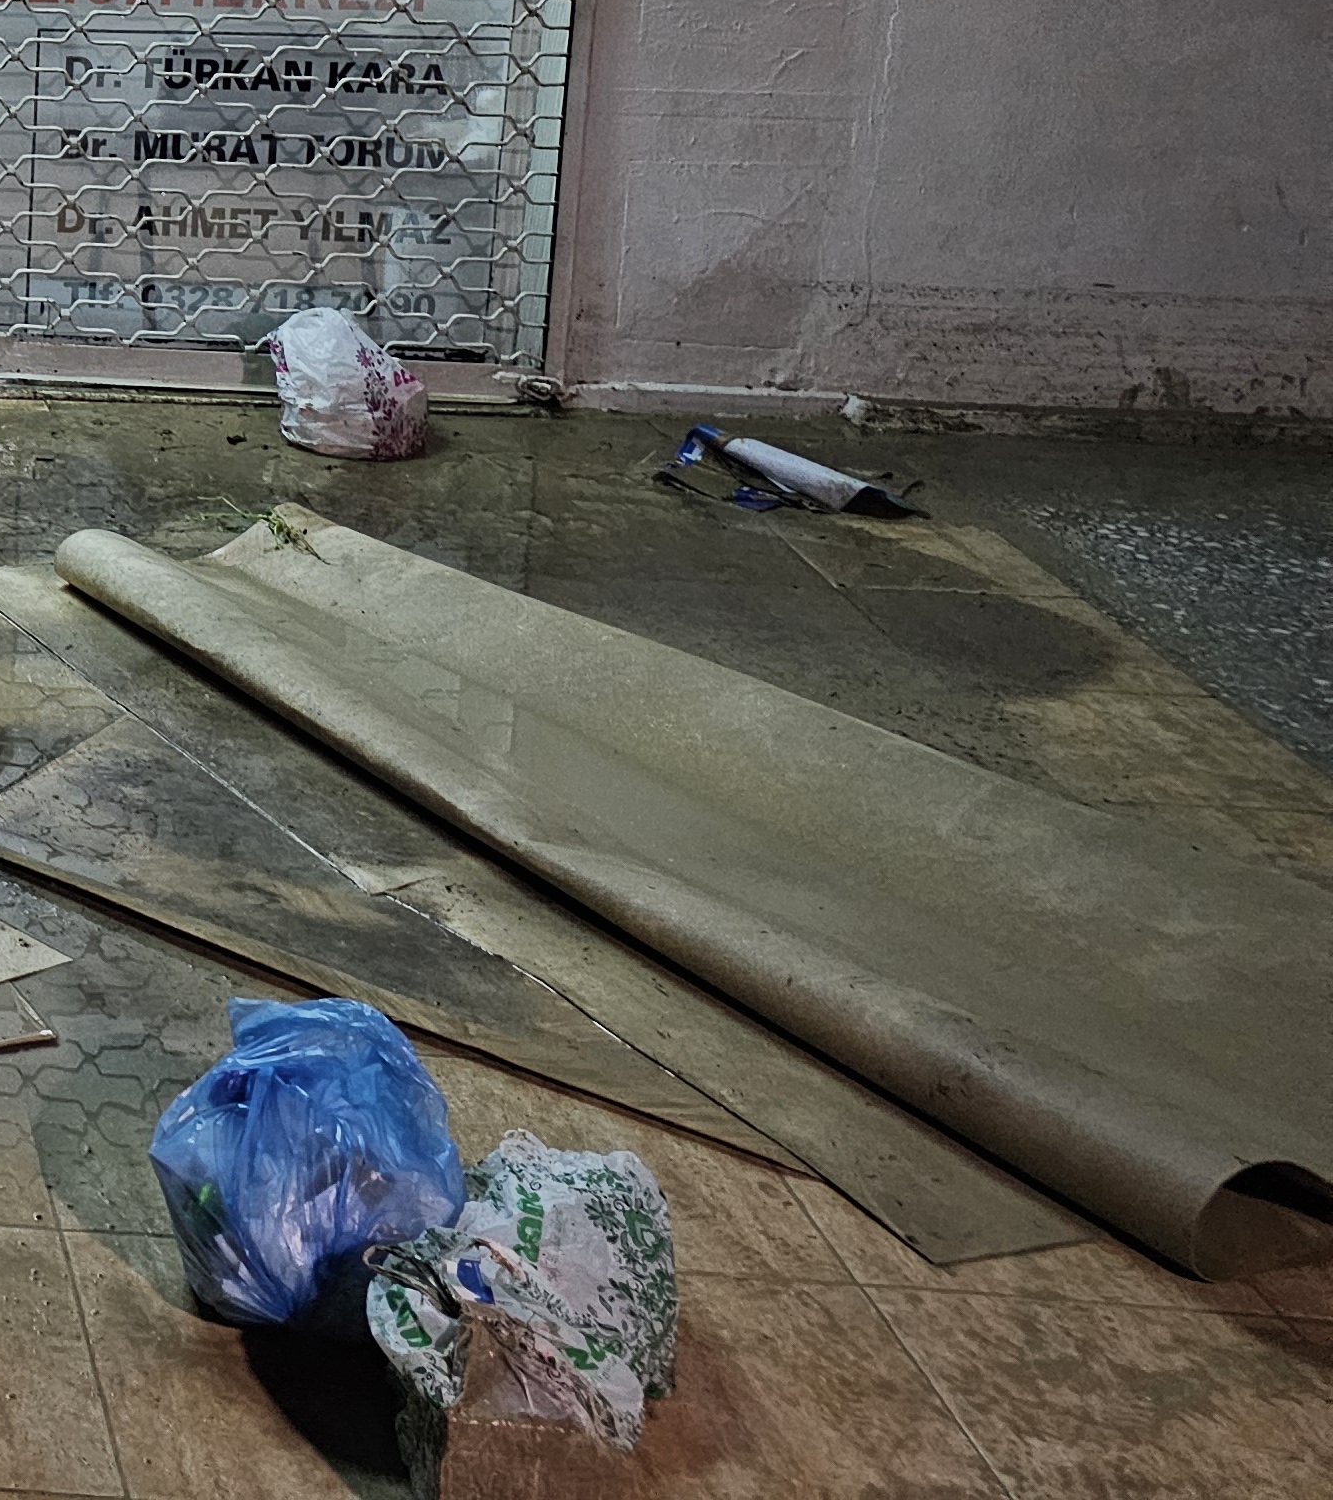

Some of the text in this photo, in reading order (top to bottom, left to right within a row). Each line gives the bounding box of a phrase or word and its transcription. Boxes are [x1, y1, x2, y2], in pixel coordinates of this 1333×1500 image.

[64, 49, 448, 96] Dr. TÜRKAN KARA
[61, 128, 447, 169] Dr. MURAT TORUN
[56, 202, 453, 246] Dr. AHMET YILMAZ
[140, 282, 234, 314] 0328
[393, 290, 435, 318] 90
